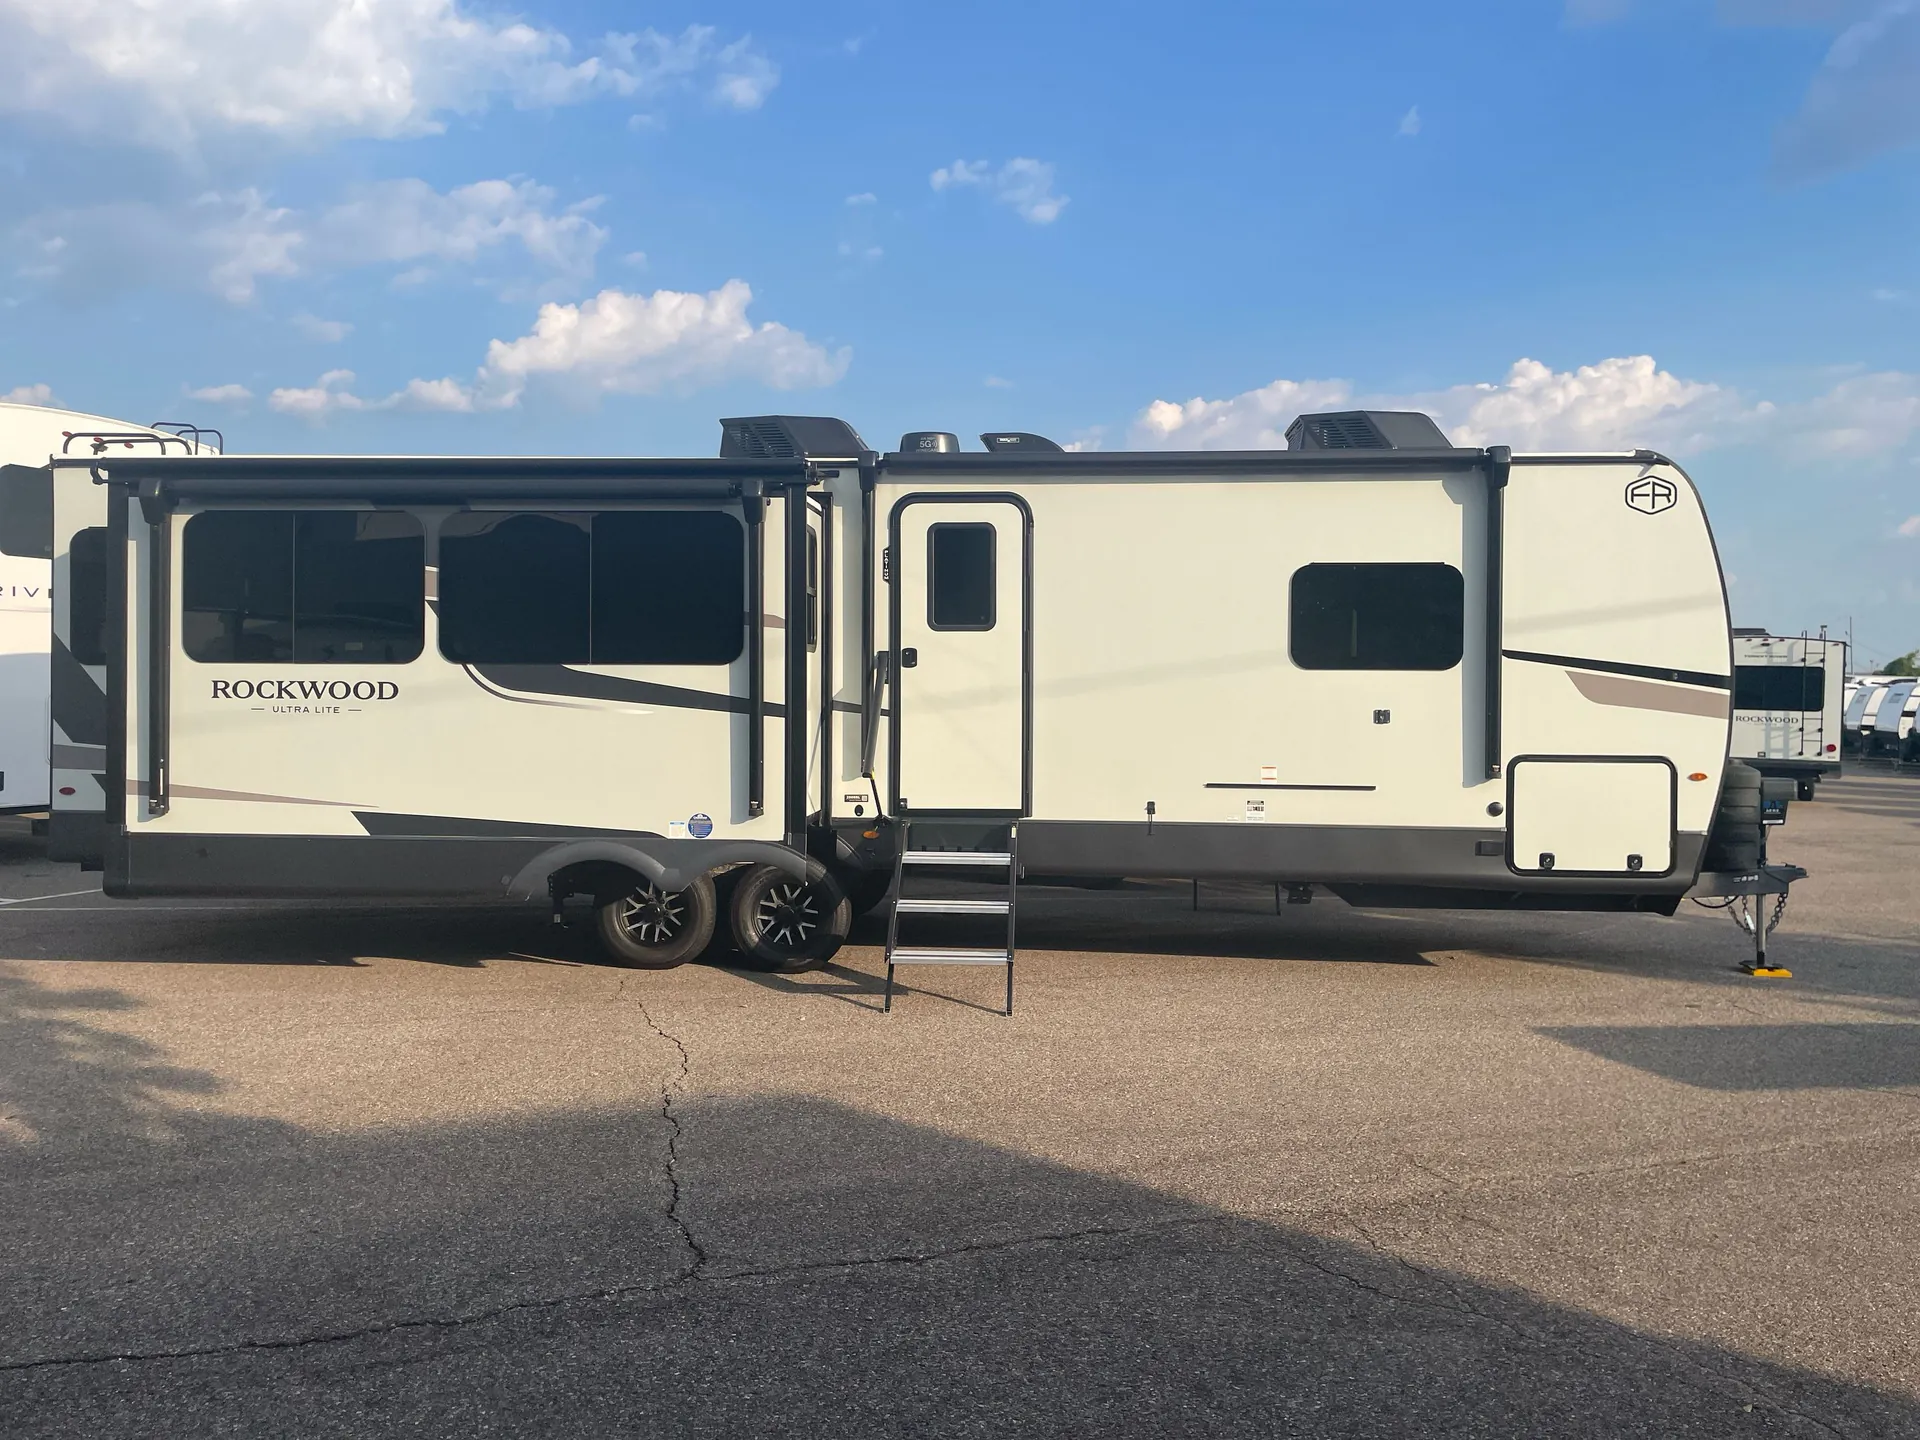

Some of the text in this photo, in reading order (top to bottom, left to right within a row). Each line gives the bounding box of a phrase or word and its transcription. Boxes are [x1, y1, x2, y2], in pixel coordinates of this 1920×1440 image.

[919, 440, 932, 448] 5G
[211, 680, 399, 700] ROCKWOOD
[272, 705, 340, 714] ULTRA LITE
[1735, 715, 1799, 724] ROCKWOOD
